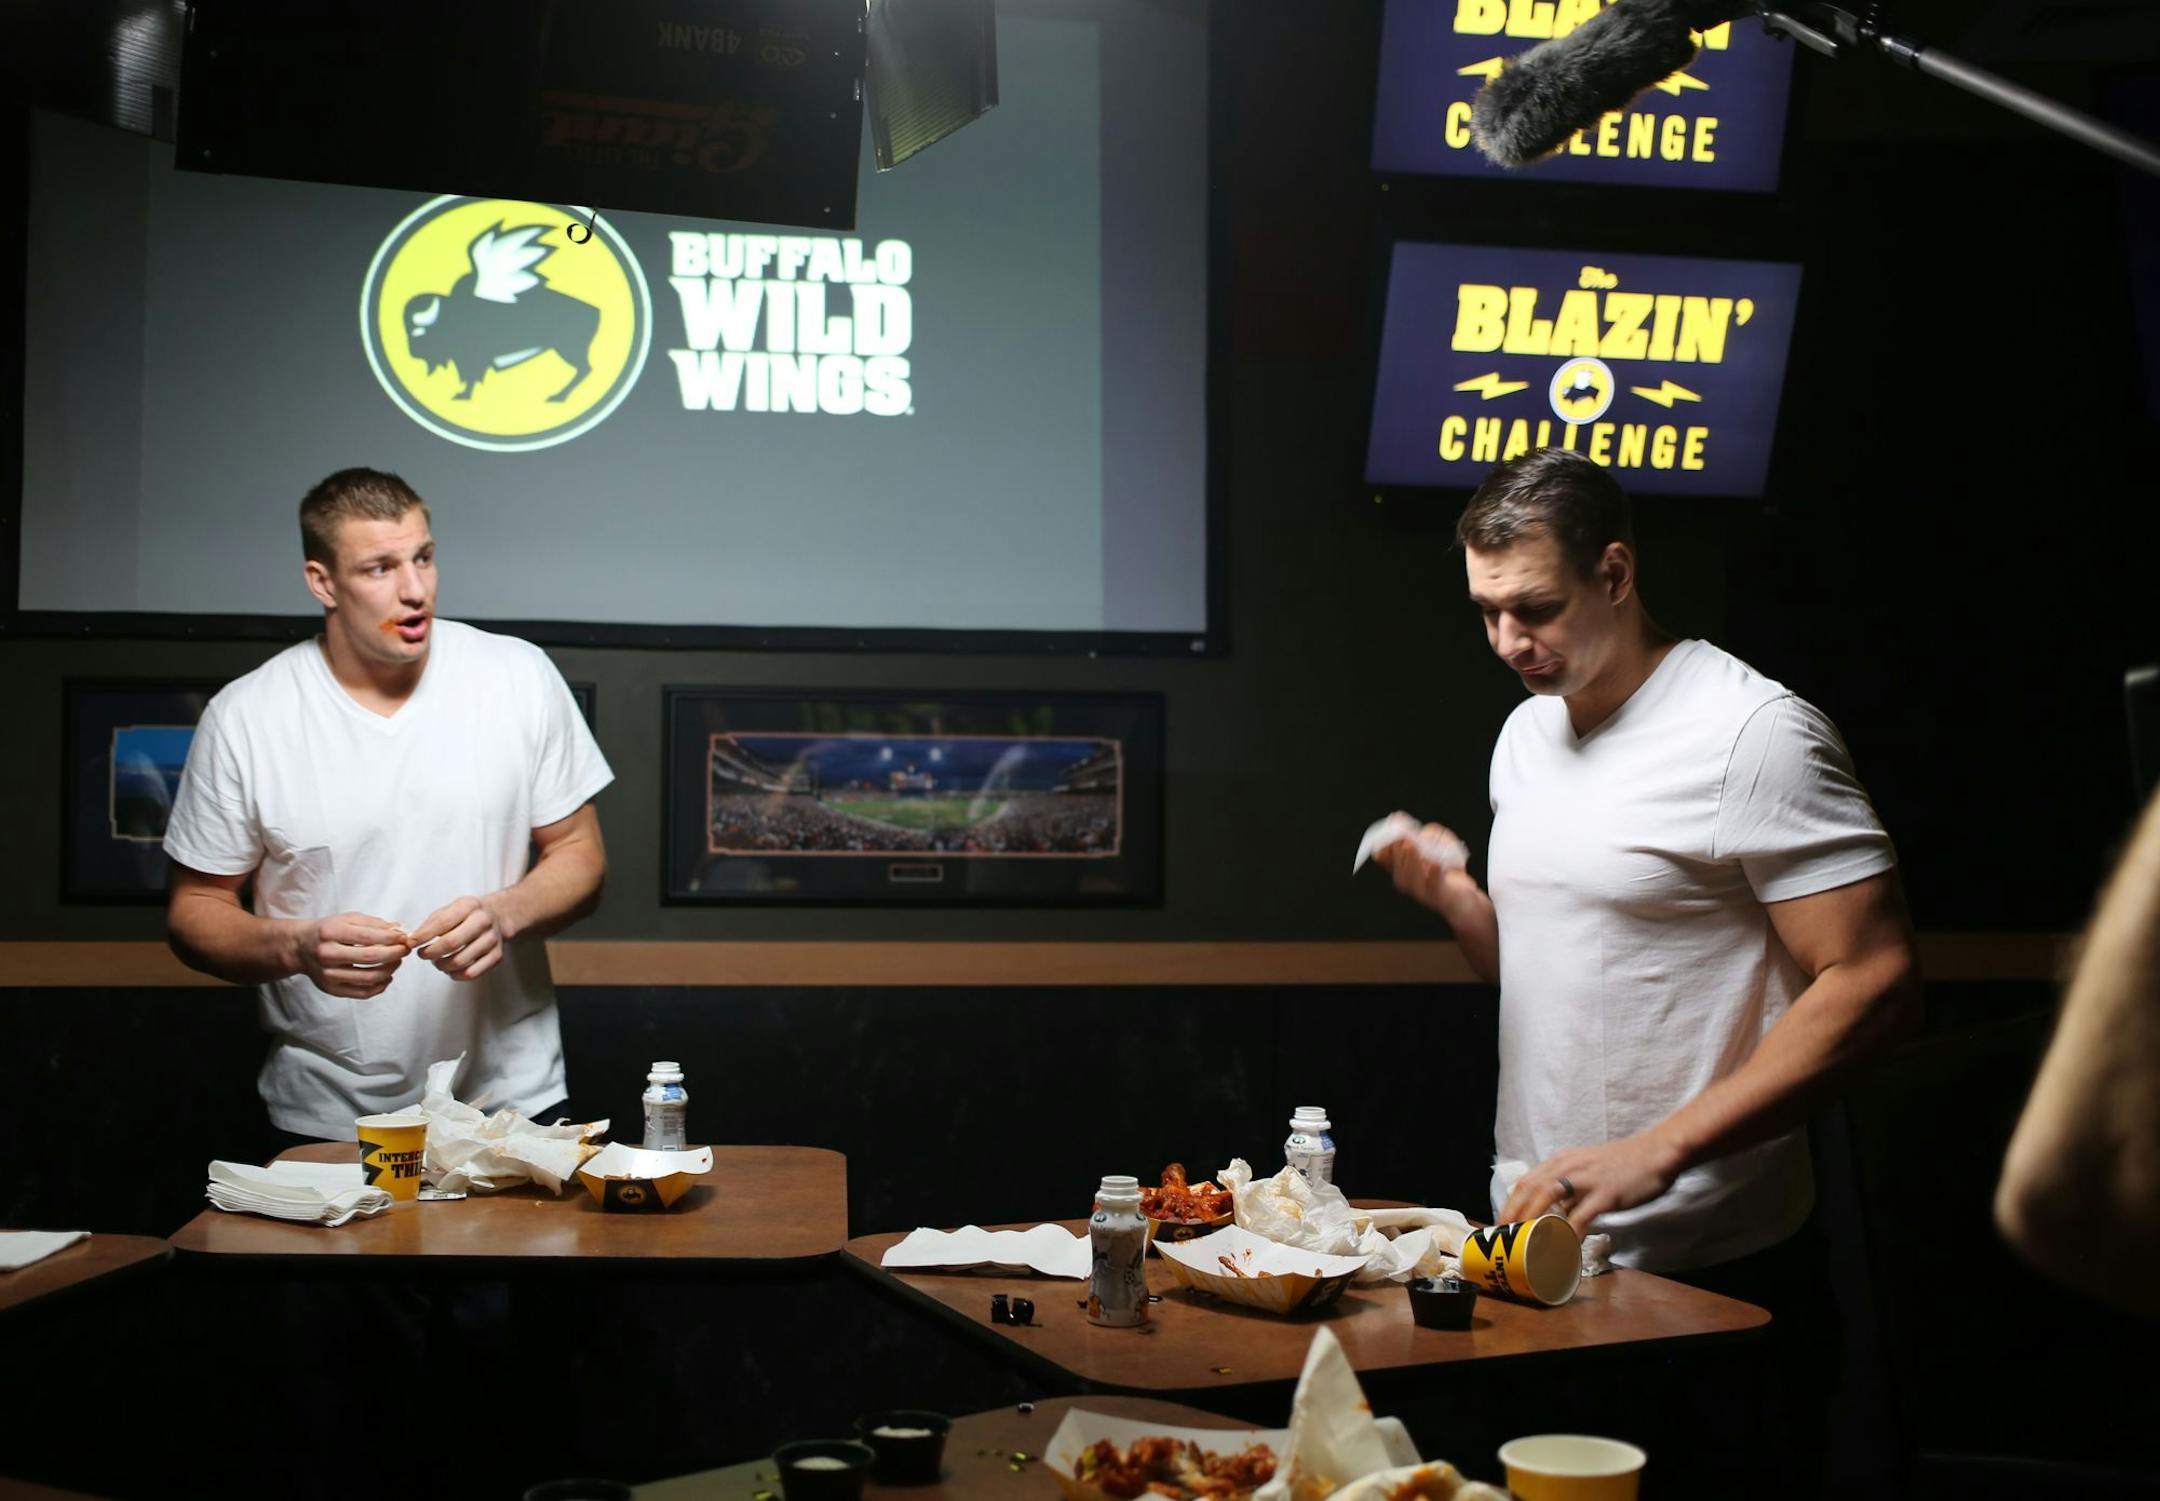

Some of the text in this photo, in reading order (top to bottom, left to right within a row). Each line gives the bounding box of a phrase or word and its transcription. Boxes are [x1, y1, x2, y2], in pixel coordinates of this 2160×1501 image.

[657, 20, 742, 55] 4BANK
[1444, 101, 1720, 163] CLENGE
[668, 231, 912, 286] BUFFALO
[1578, 265, 1618, 289] The
[668, 276, 912, 357] WILD
[1451, 284, 1755, 363] BLAZIN'
[667, 349, 913, 416] WINGS
